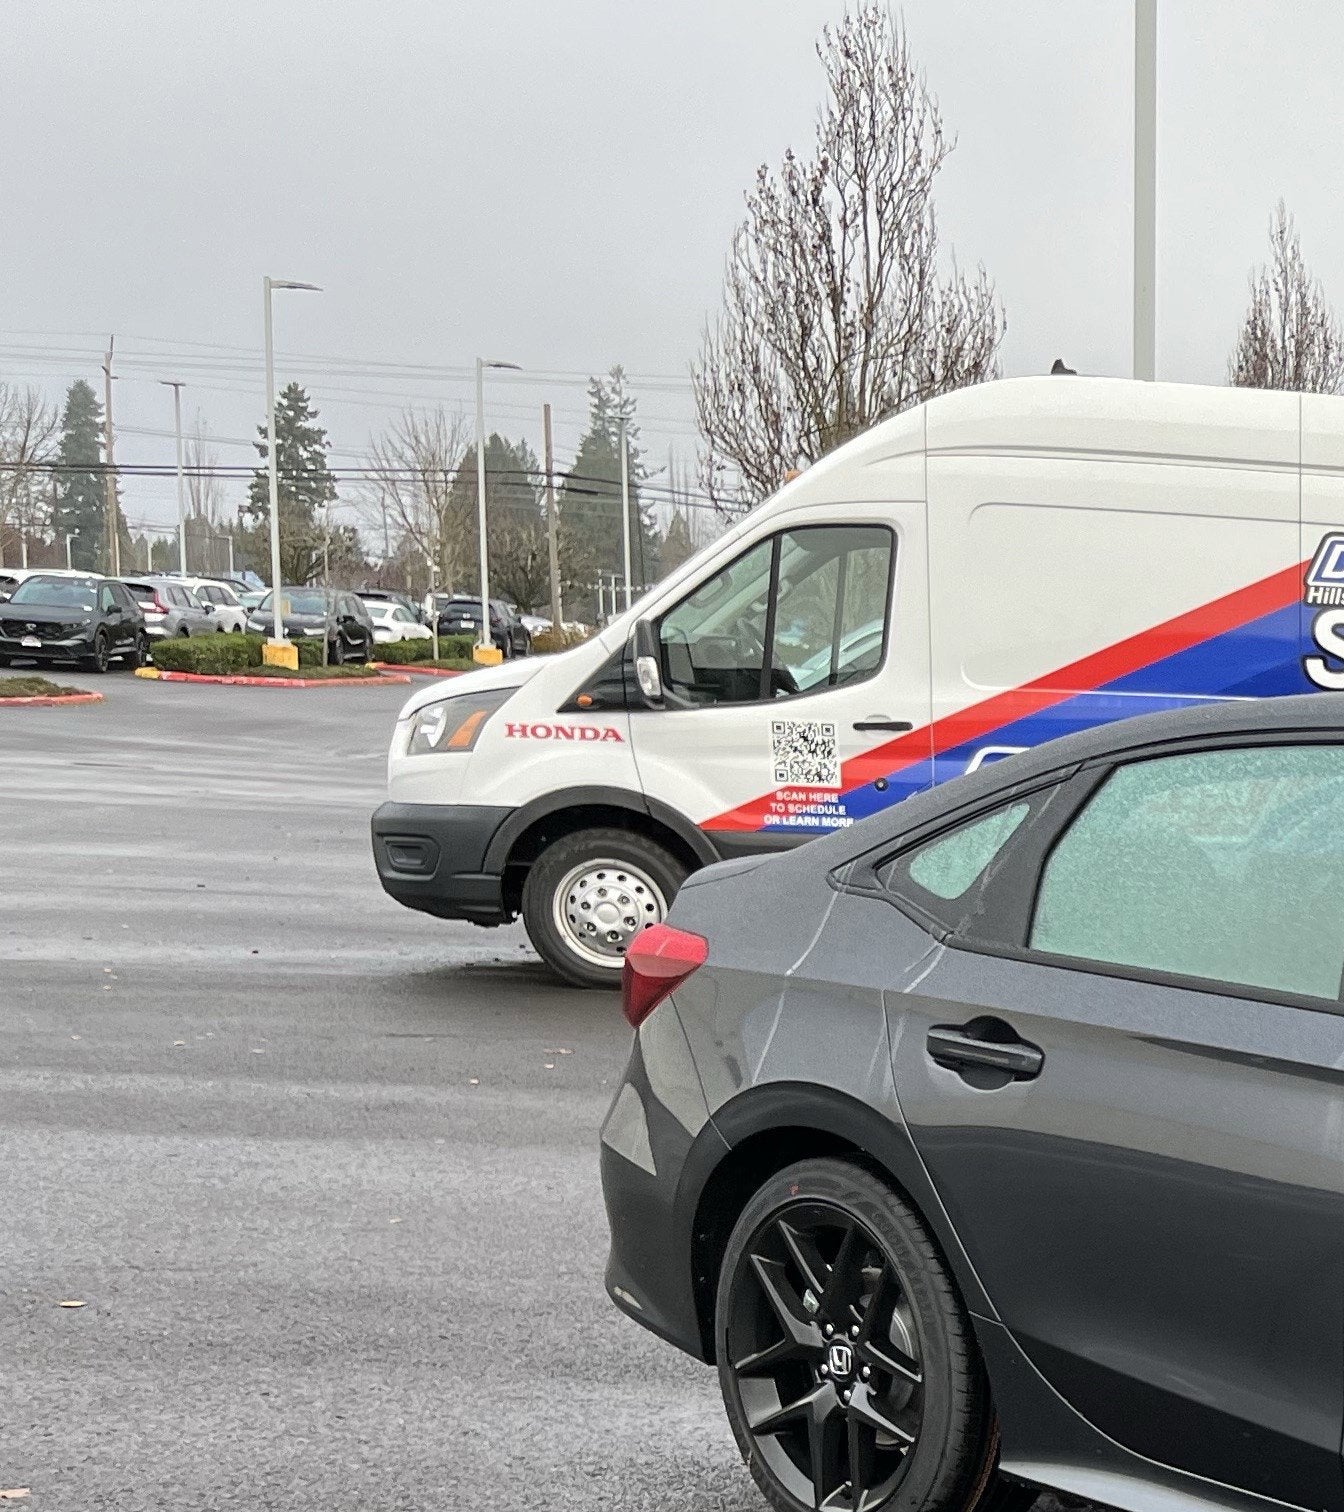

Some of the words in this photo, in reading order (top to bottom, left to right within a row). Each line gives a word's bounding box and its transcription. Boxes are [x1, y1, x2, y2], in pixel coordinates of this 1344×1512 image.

[505, 723, 625, 742] HONDA
[775, 790, 807, 802] SCAN
[808, 792, 839, 804] HERE
[769, 802, 786, 813] TO
[787, 803, 847, 815] SCHEDULE
[763, 813, 781, 825] OR
[782, 815, 820, 826] LEARN
